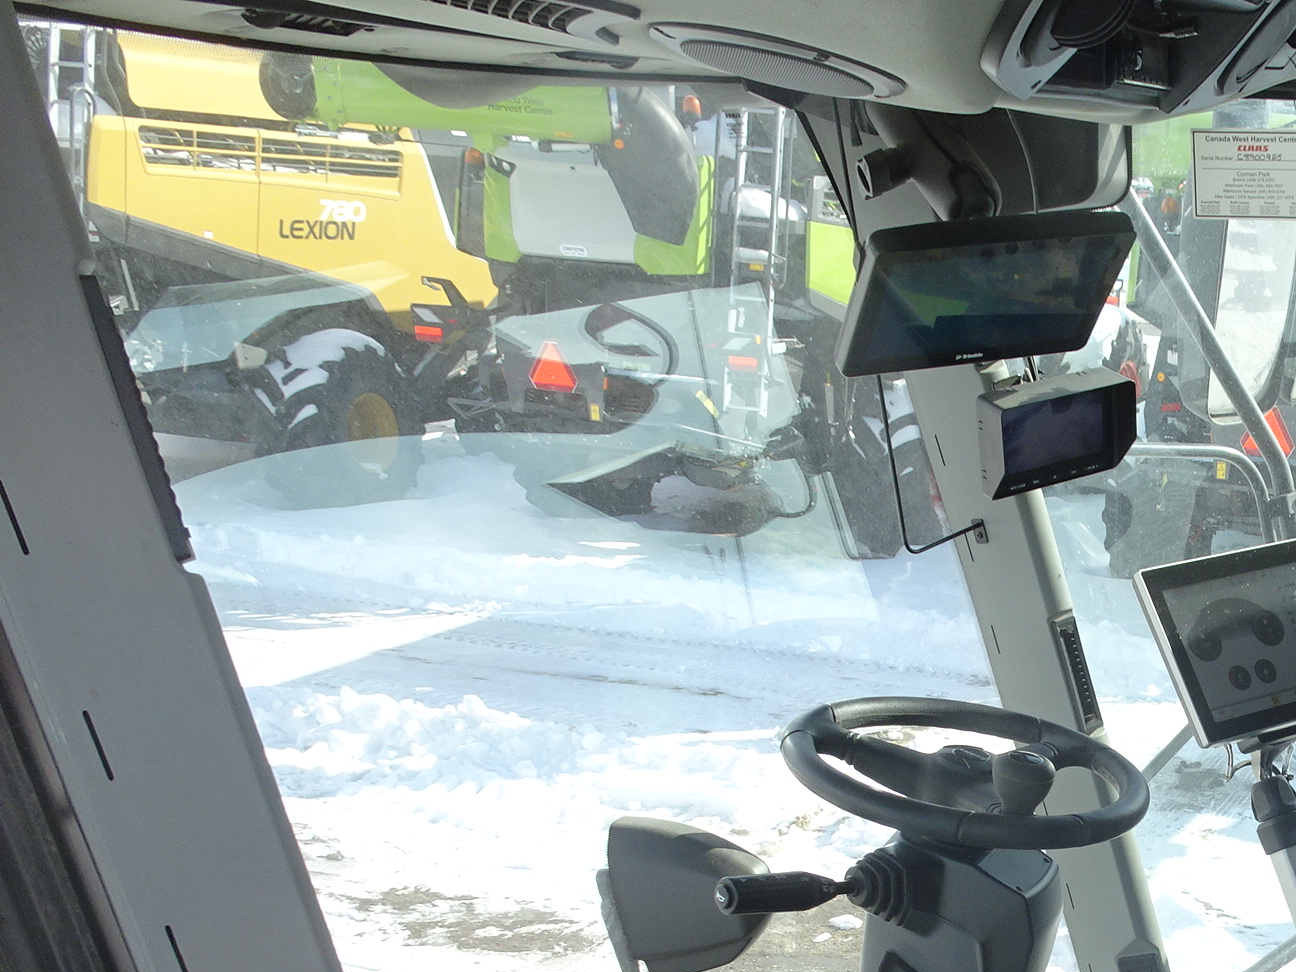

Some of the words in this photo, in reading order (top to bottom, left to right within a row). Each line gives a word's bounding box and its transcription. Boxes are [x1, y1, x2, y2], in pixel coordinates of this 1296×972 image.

[488, 104, 522, 113] Harvest
[524, 106, 554, 116] Centre
[319, 199, 367, 222] 780
[279, 219, 356, 240] LEXION
